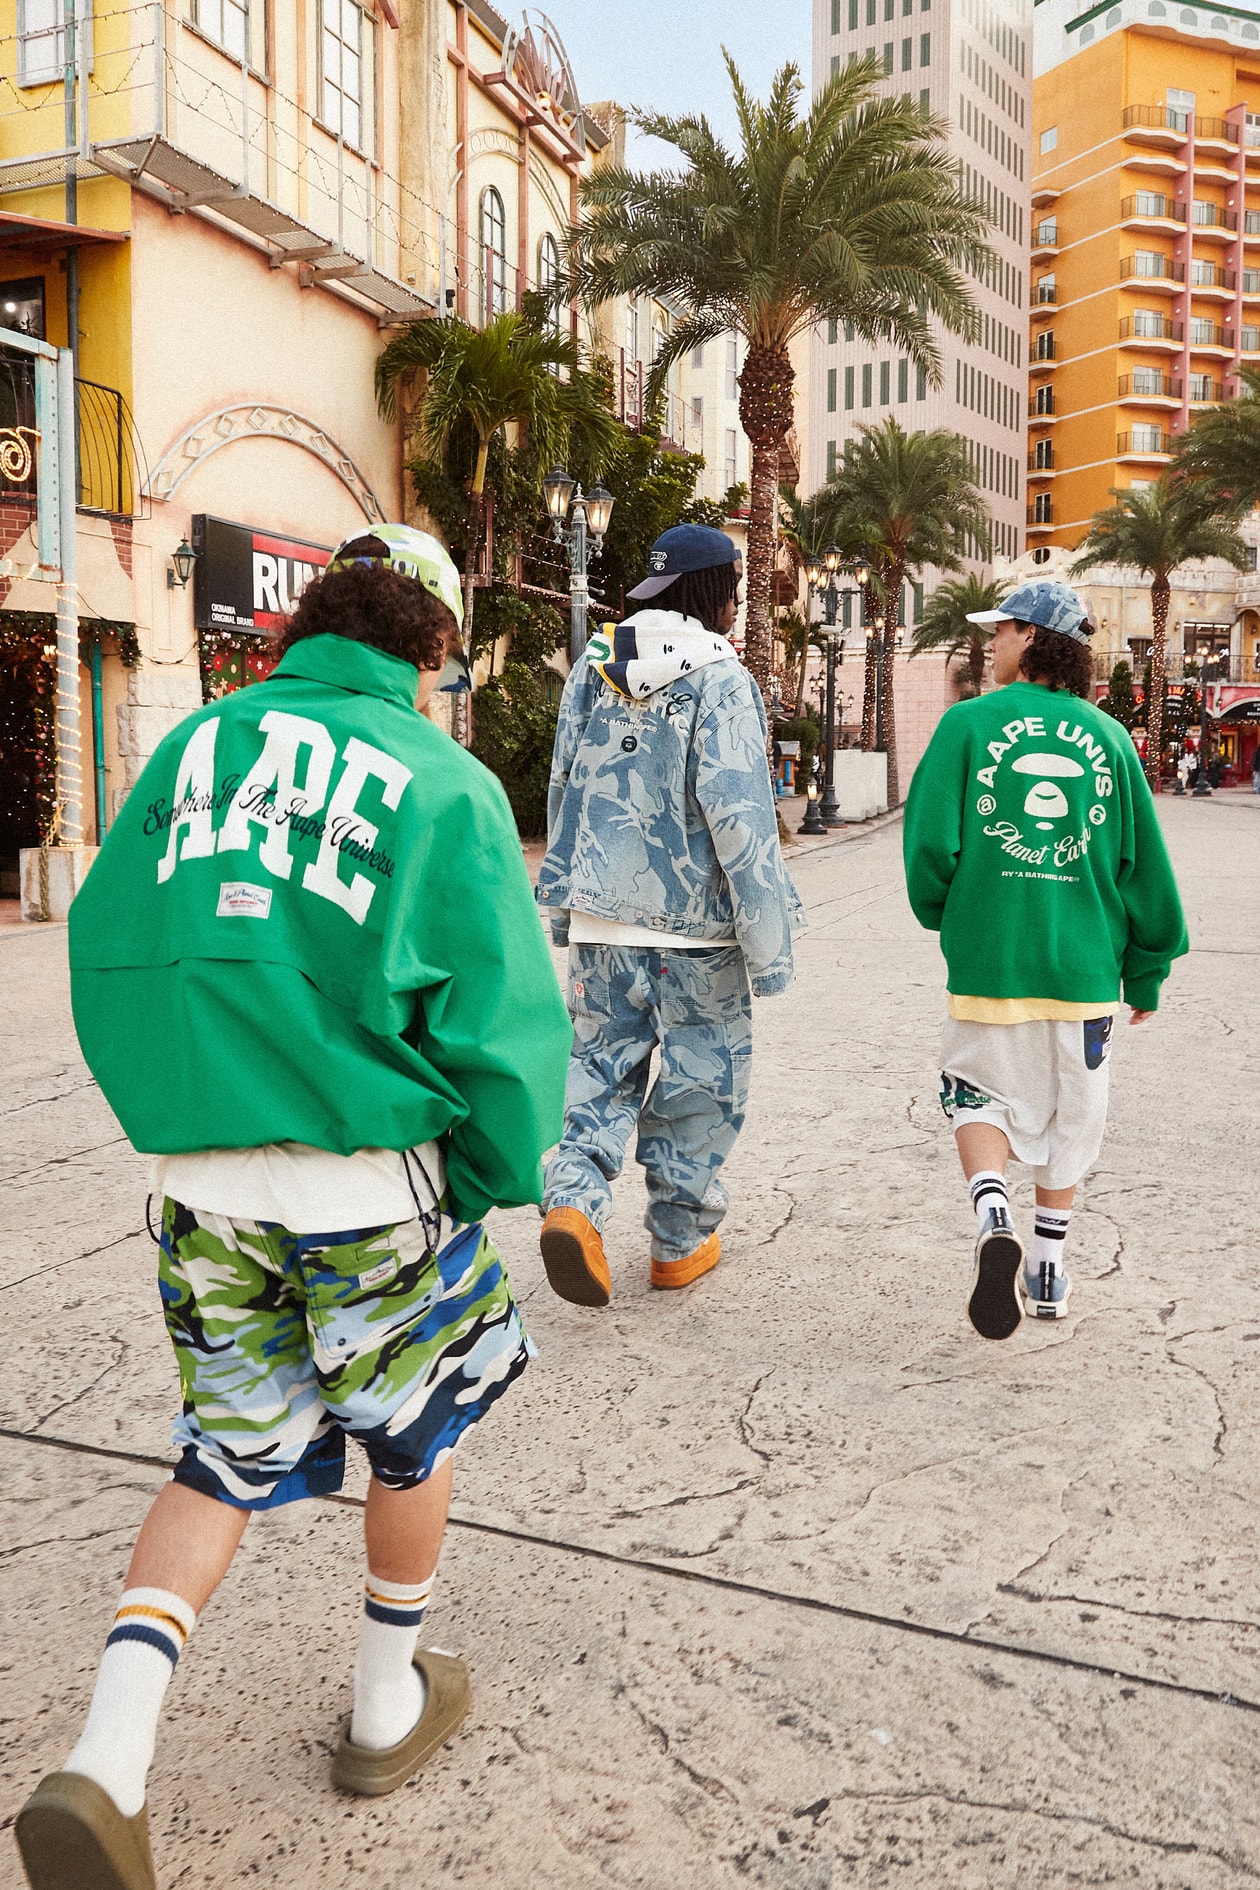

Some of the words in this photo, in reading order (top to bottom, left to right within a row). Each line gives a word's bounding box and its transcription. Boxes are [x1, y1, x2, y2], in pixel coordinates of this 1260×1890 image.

[976, 717, 1047, 789] AAPE
[1056, 720, 1113, 797] UNVS
[238, 784, 279, 819] The
[275, 797, 327, 842] Aape
[330, 816, 395, 879] Universe
[983, 821, 1051, 865] Planet
